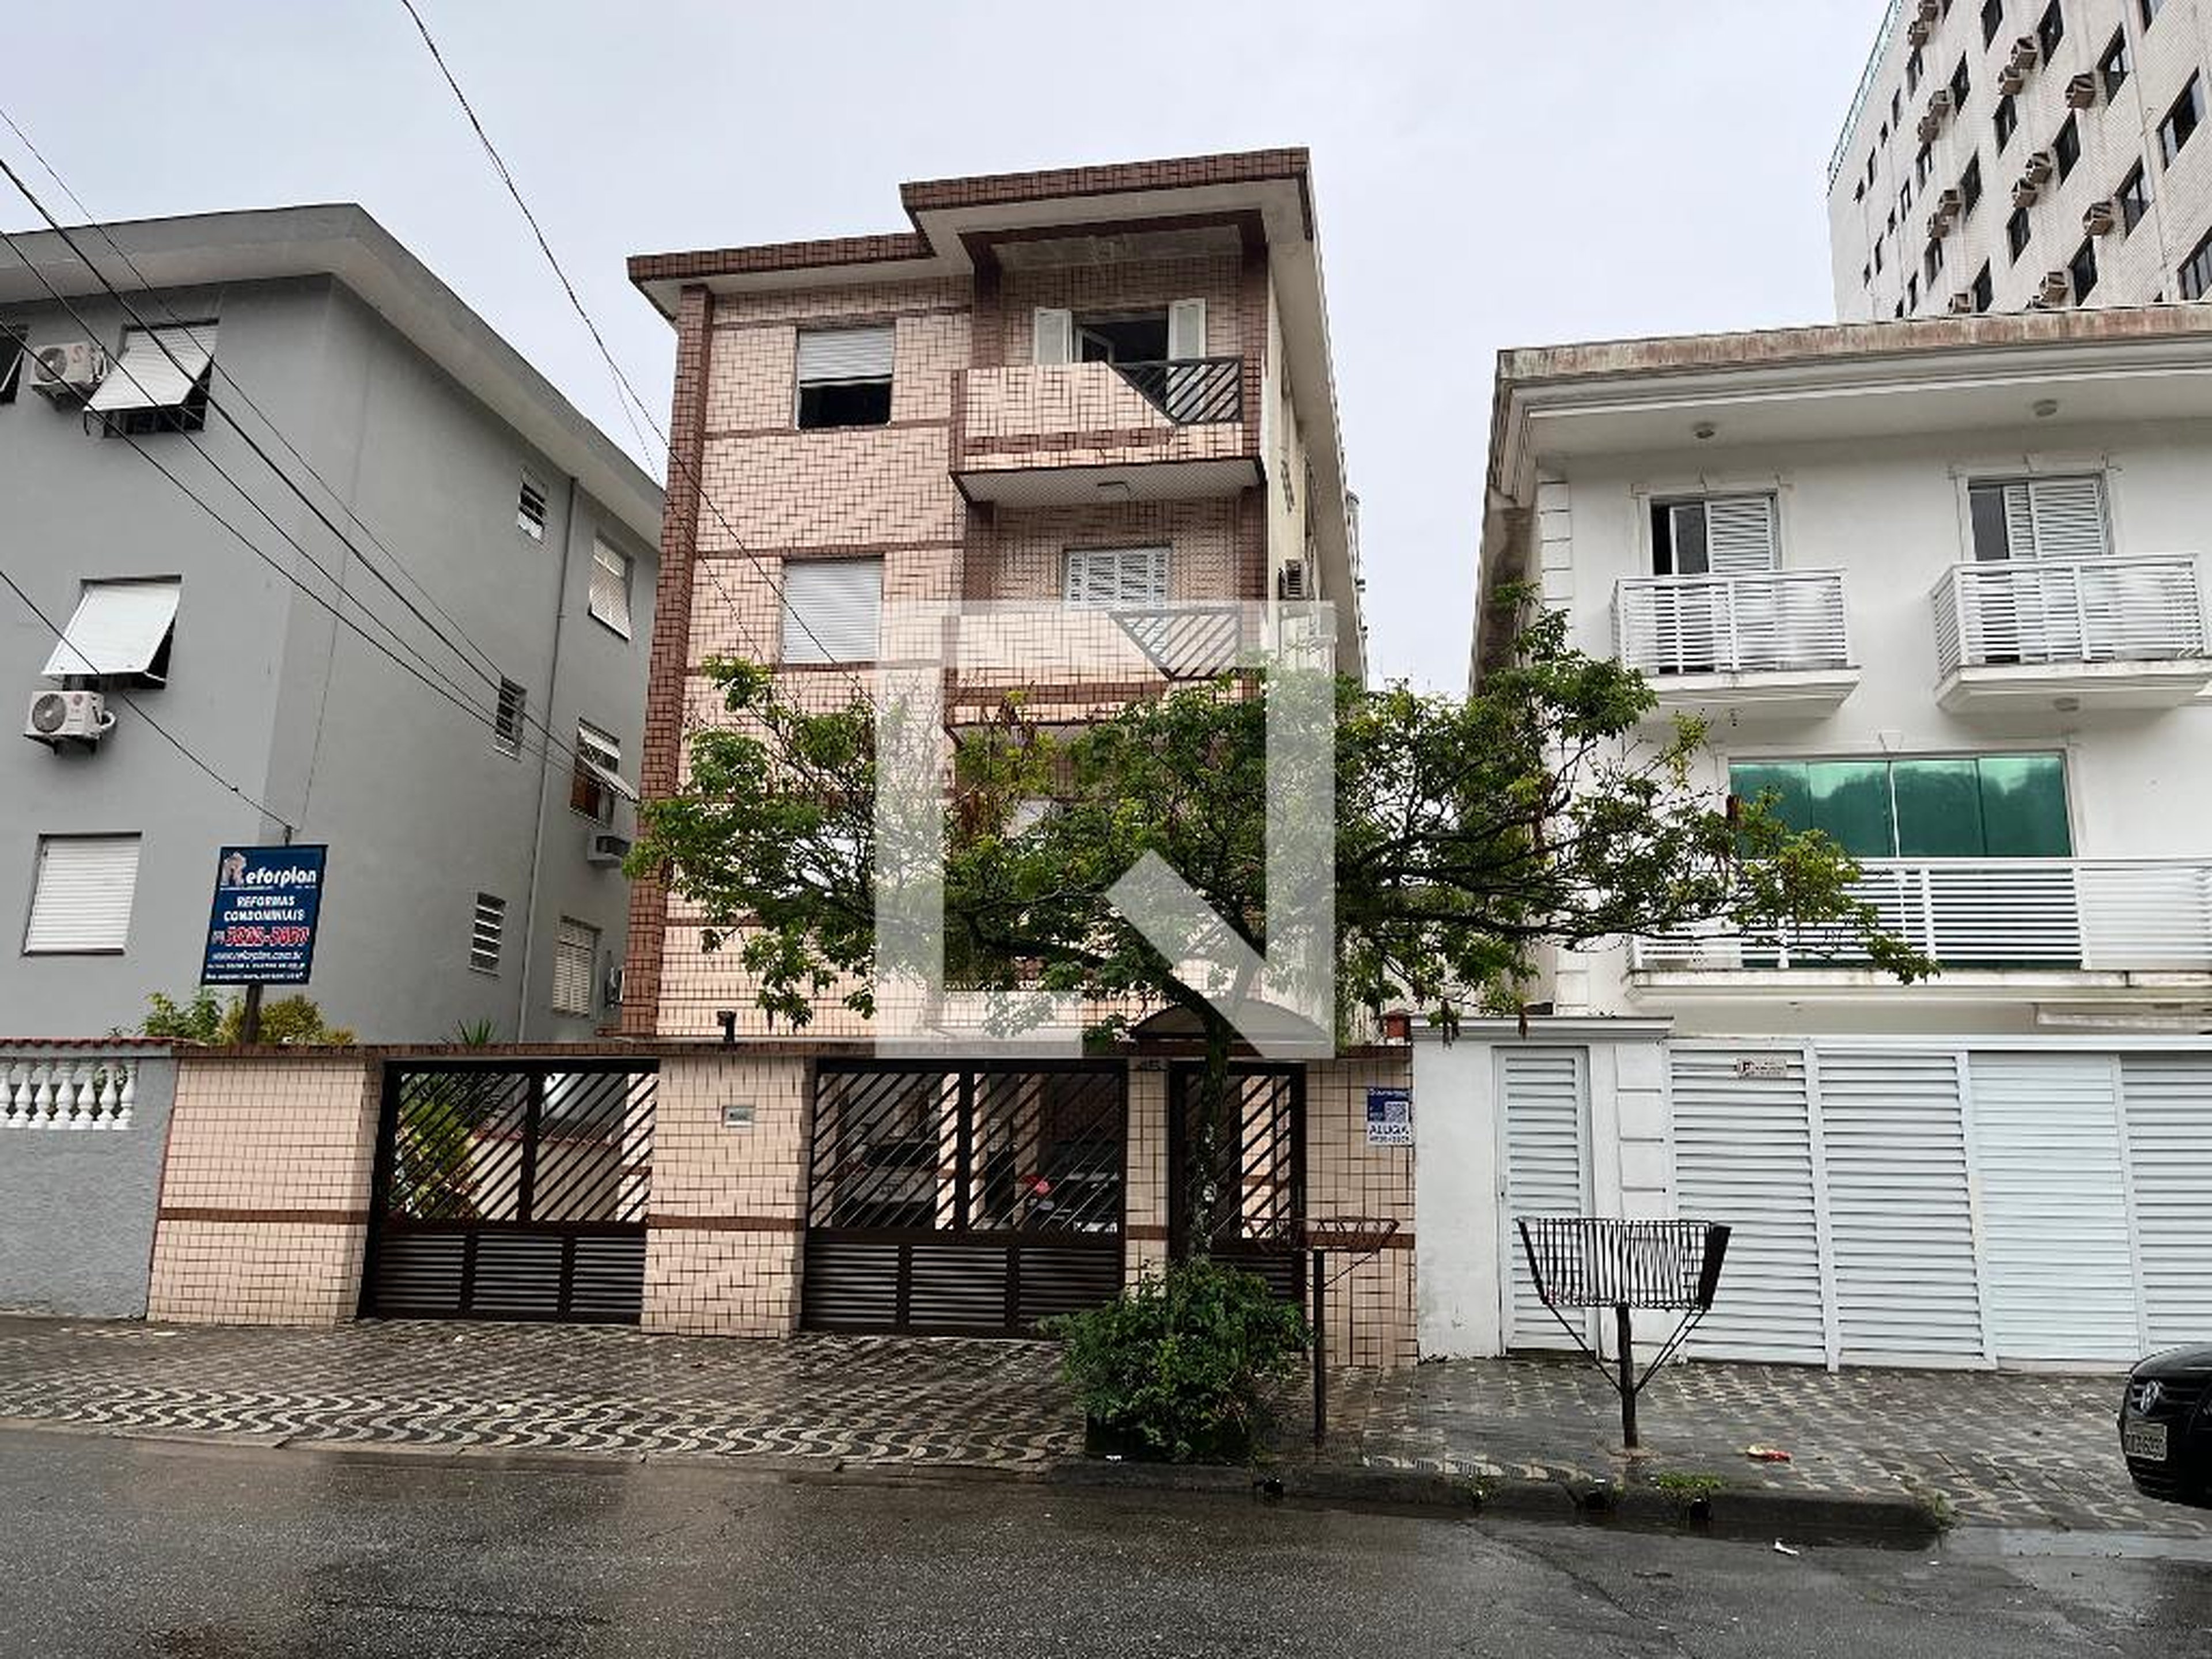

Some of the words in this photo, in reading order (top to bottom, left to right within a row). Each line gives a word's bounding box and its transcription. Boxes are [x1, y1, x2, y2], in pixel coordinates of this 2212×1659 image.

[237, 895, 296, 908] REFORMAS
[224, 909, 306, 922] CONDOMINIAIS
[1369, 1124, 1409, 1135] ALUGA
